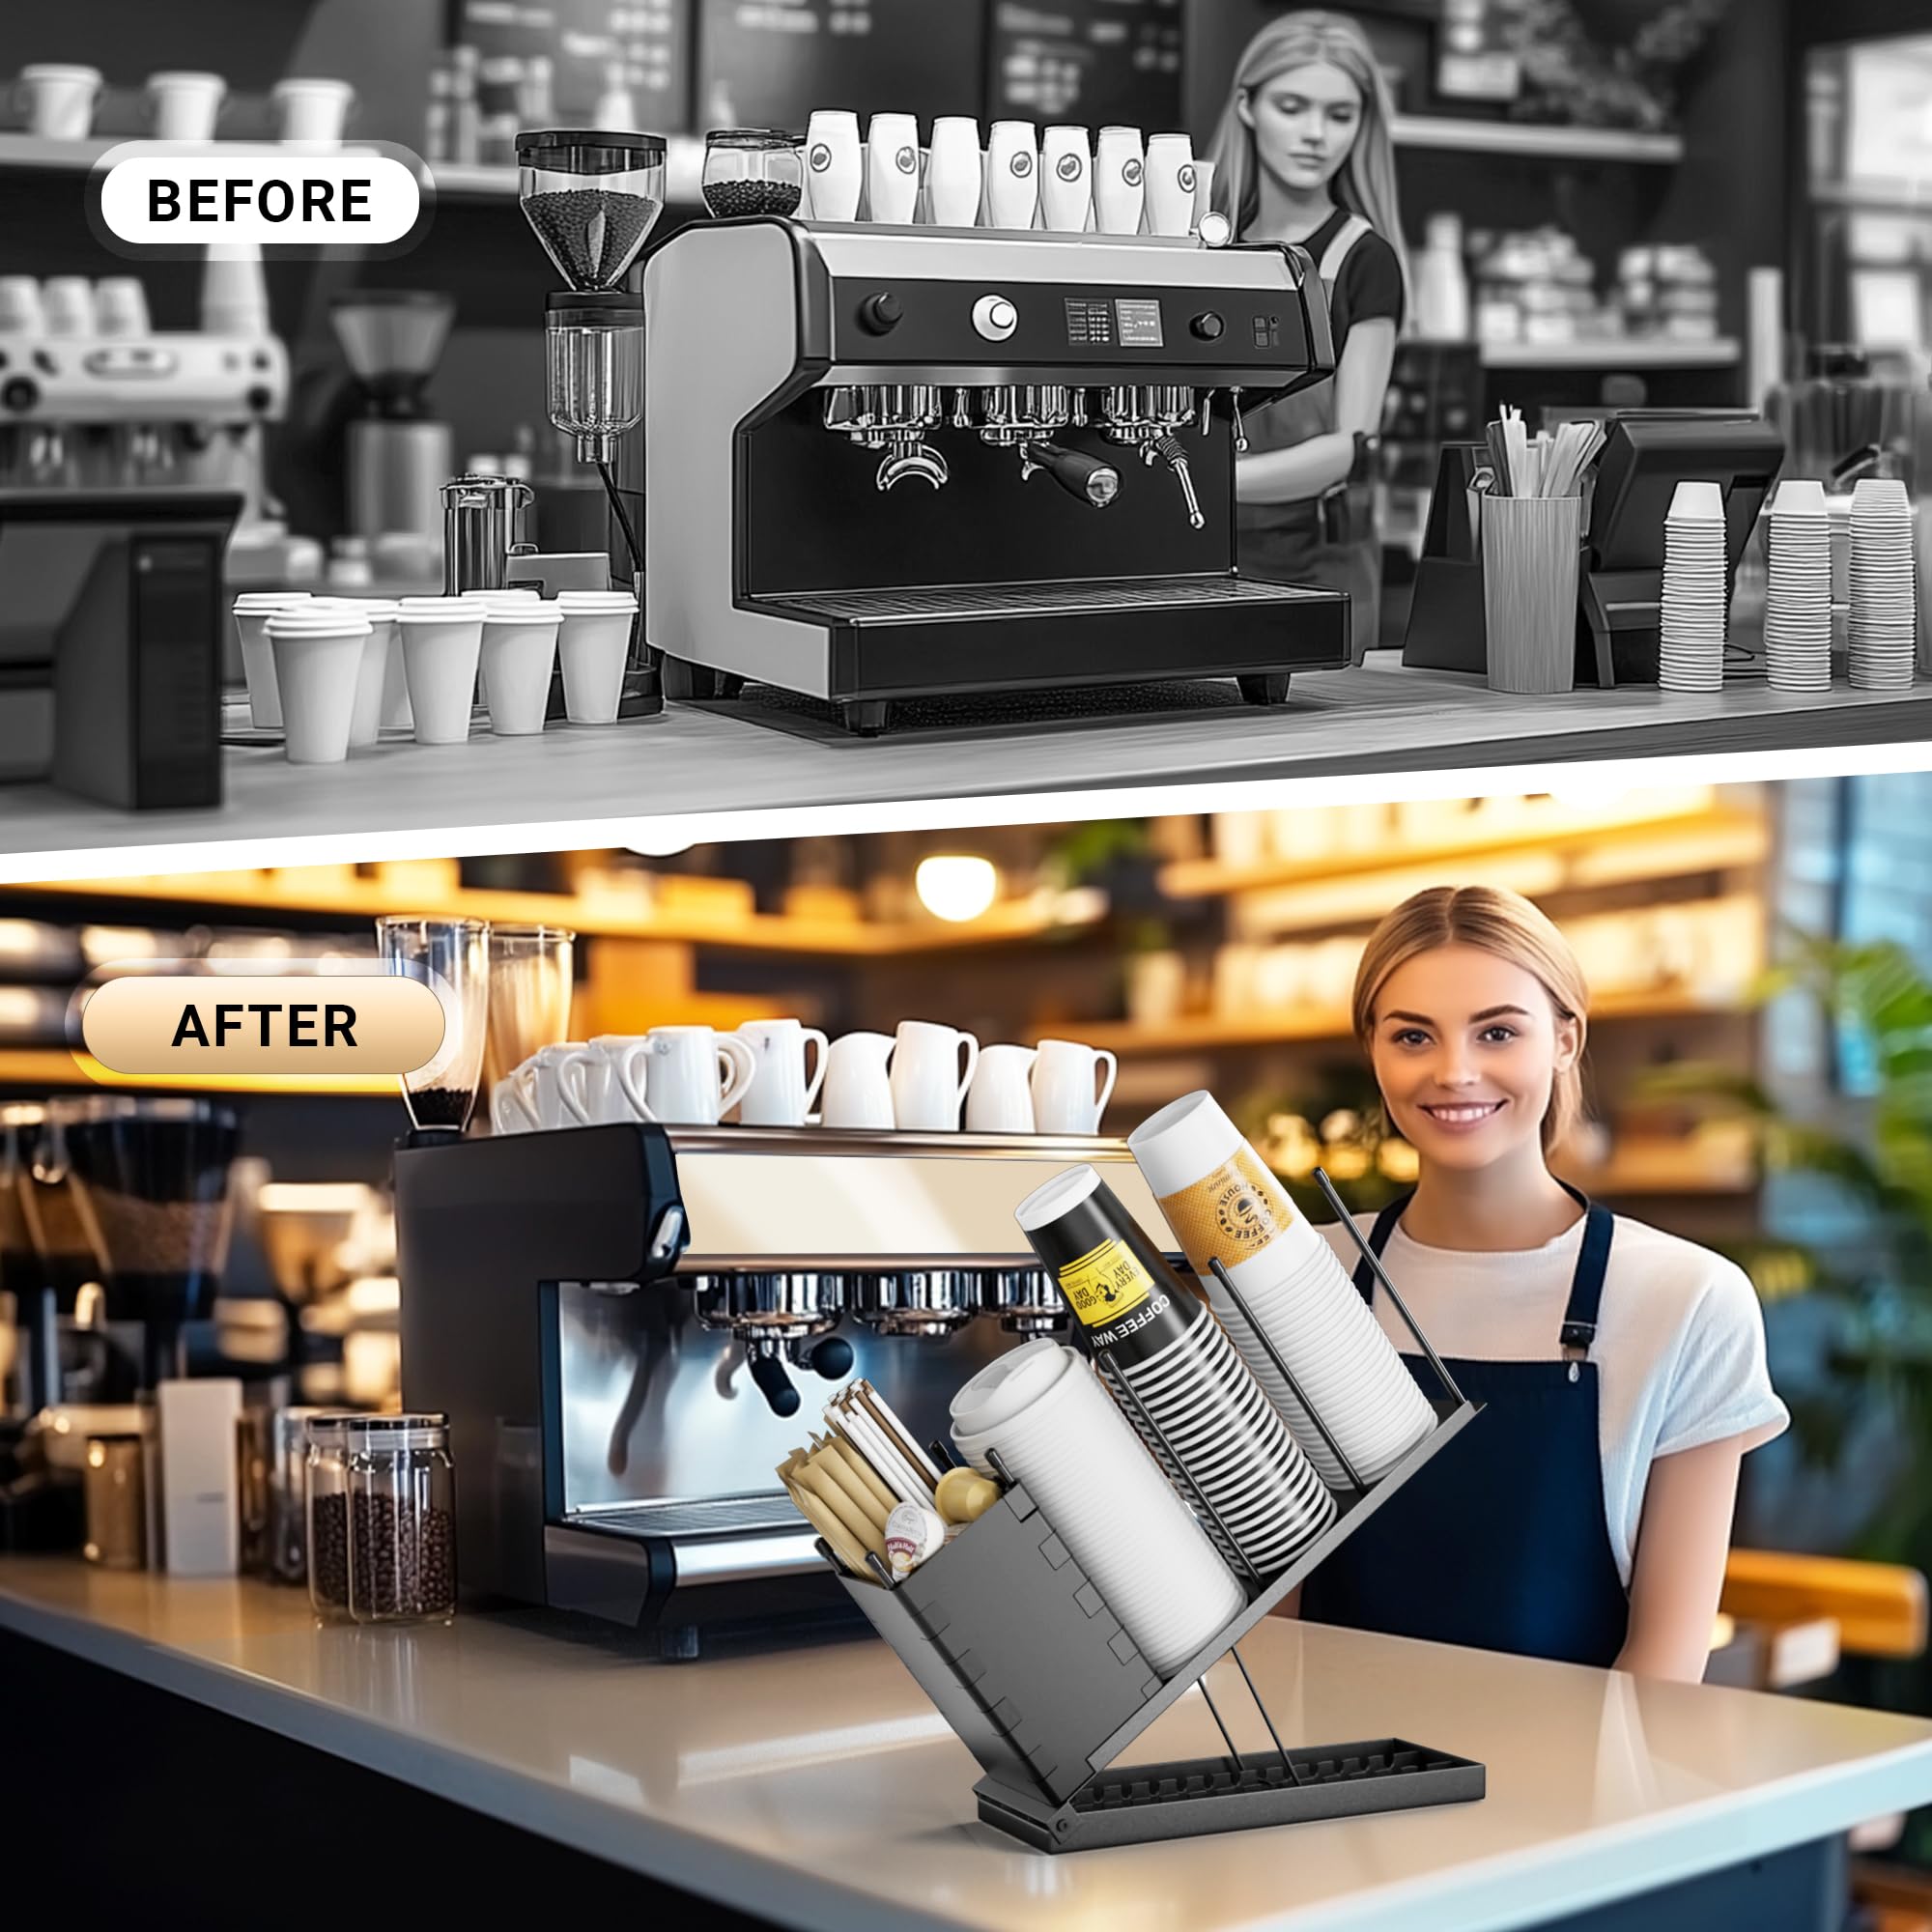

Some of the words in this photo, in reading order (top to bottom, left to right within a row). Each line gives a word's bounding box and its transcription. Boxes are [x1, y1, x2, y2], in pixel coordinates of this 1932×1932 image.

[1219, 1181, 1248, 1207] HOUSE
[1235, 1208, 1271, 1238] COFFEE
[1113, 1260, 1131, 1278] DAY
[1115, 1266, 1141, 1292] EVERY
[1072, 1287, 1090, 1300] DAY
[1075, 1296, 1097, 1310] GOOD
[1115, 1294, 1171, 1339] COFFEE
[1091, 1330, 1119, 1348] WAY
